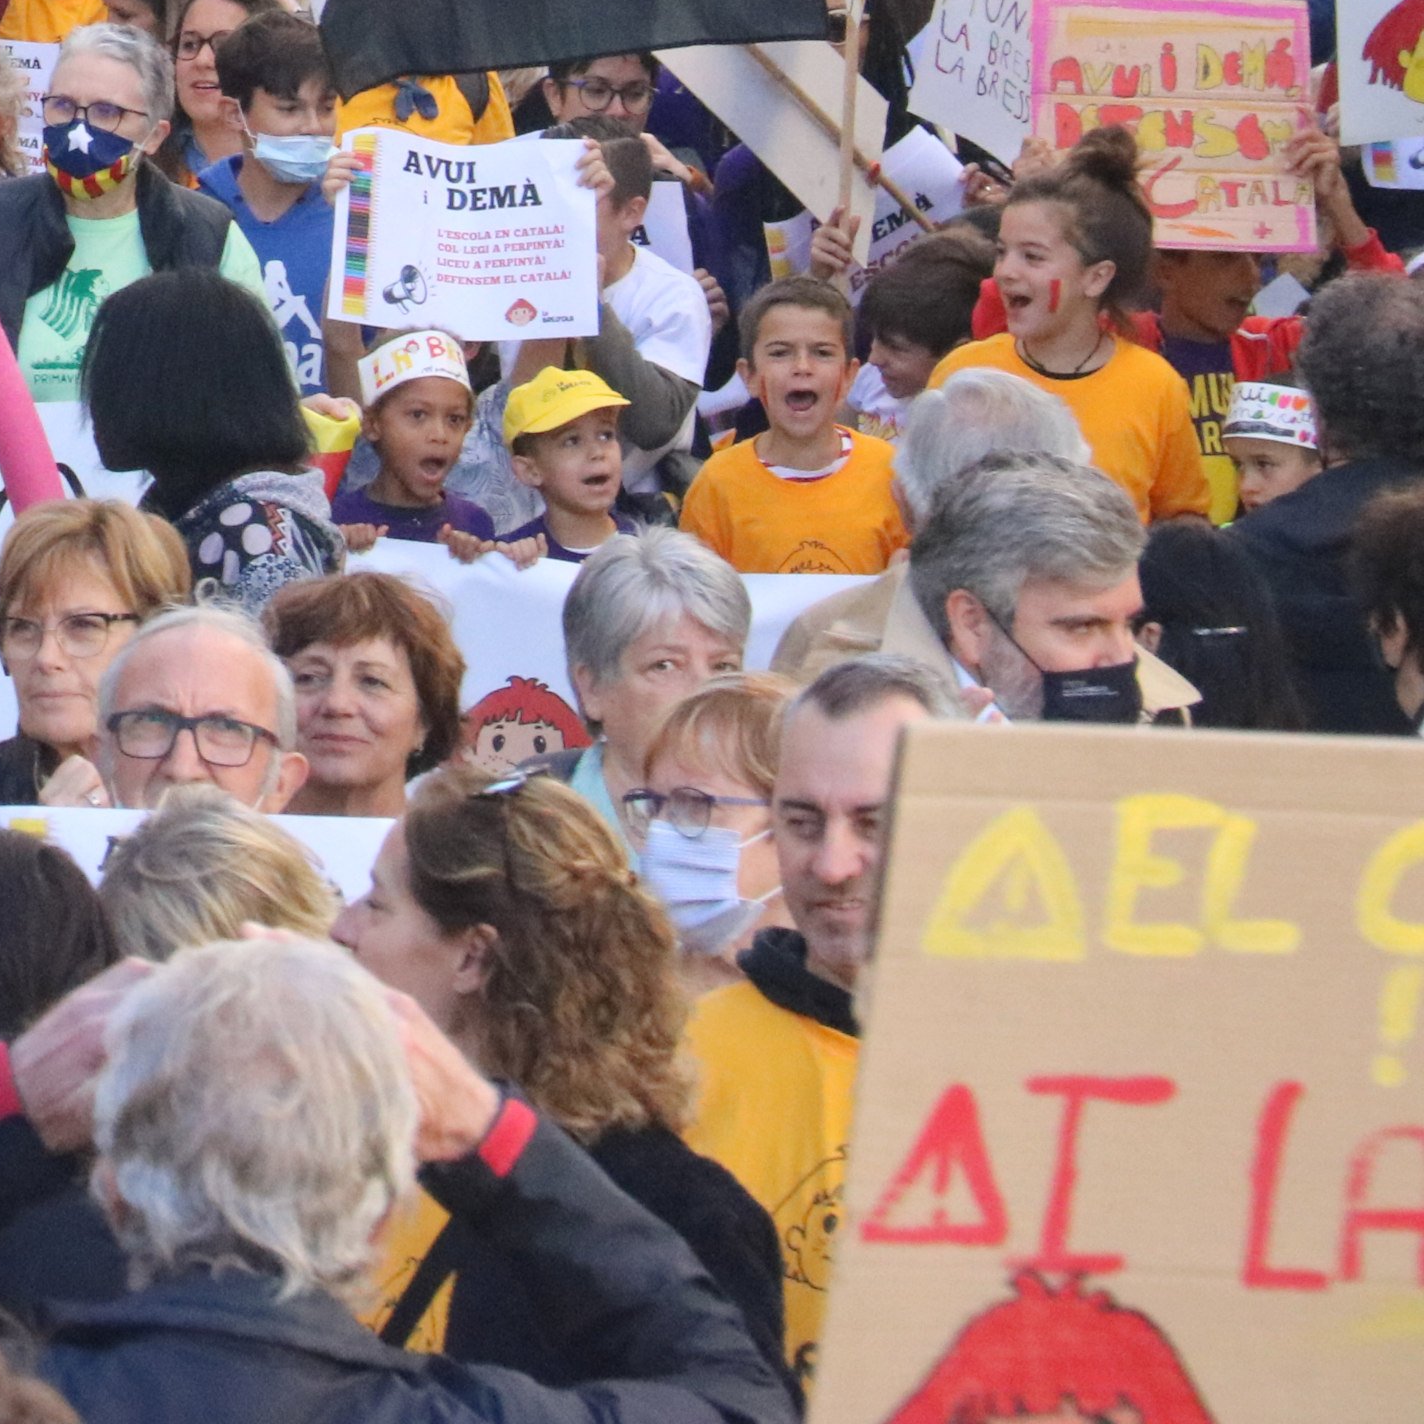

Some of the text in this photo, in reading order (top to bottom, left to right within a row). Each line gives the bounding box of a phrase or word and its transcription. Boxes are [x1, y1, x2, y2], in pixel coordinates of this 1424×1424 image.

[940, 9, 1032, 84] LA BRES
[934, 39, 1032, 124] LA BRESS
[402, 149, 477, 185] AVUI
[423, 177, 543, 212] i DEMÀ
[437, 224, 566, 241] L'ESCOLA EN CATALÀ!
[437, 239, 566, 255] COL LEGI A PERPINYÀ!
[436, 255, 547, 269] LICEU A PERPINYÀ!
[436, 271, 572, 286] DEFENSEM EL CATALÀ!
